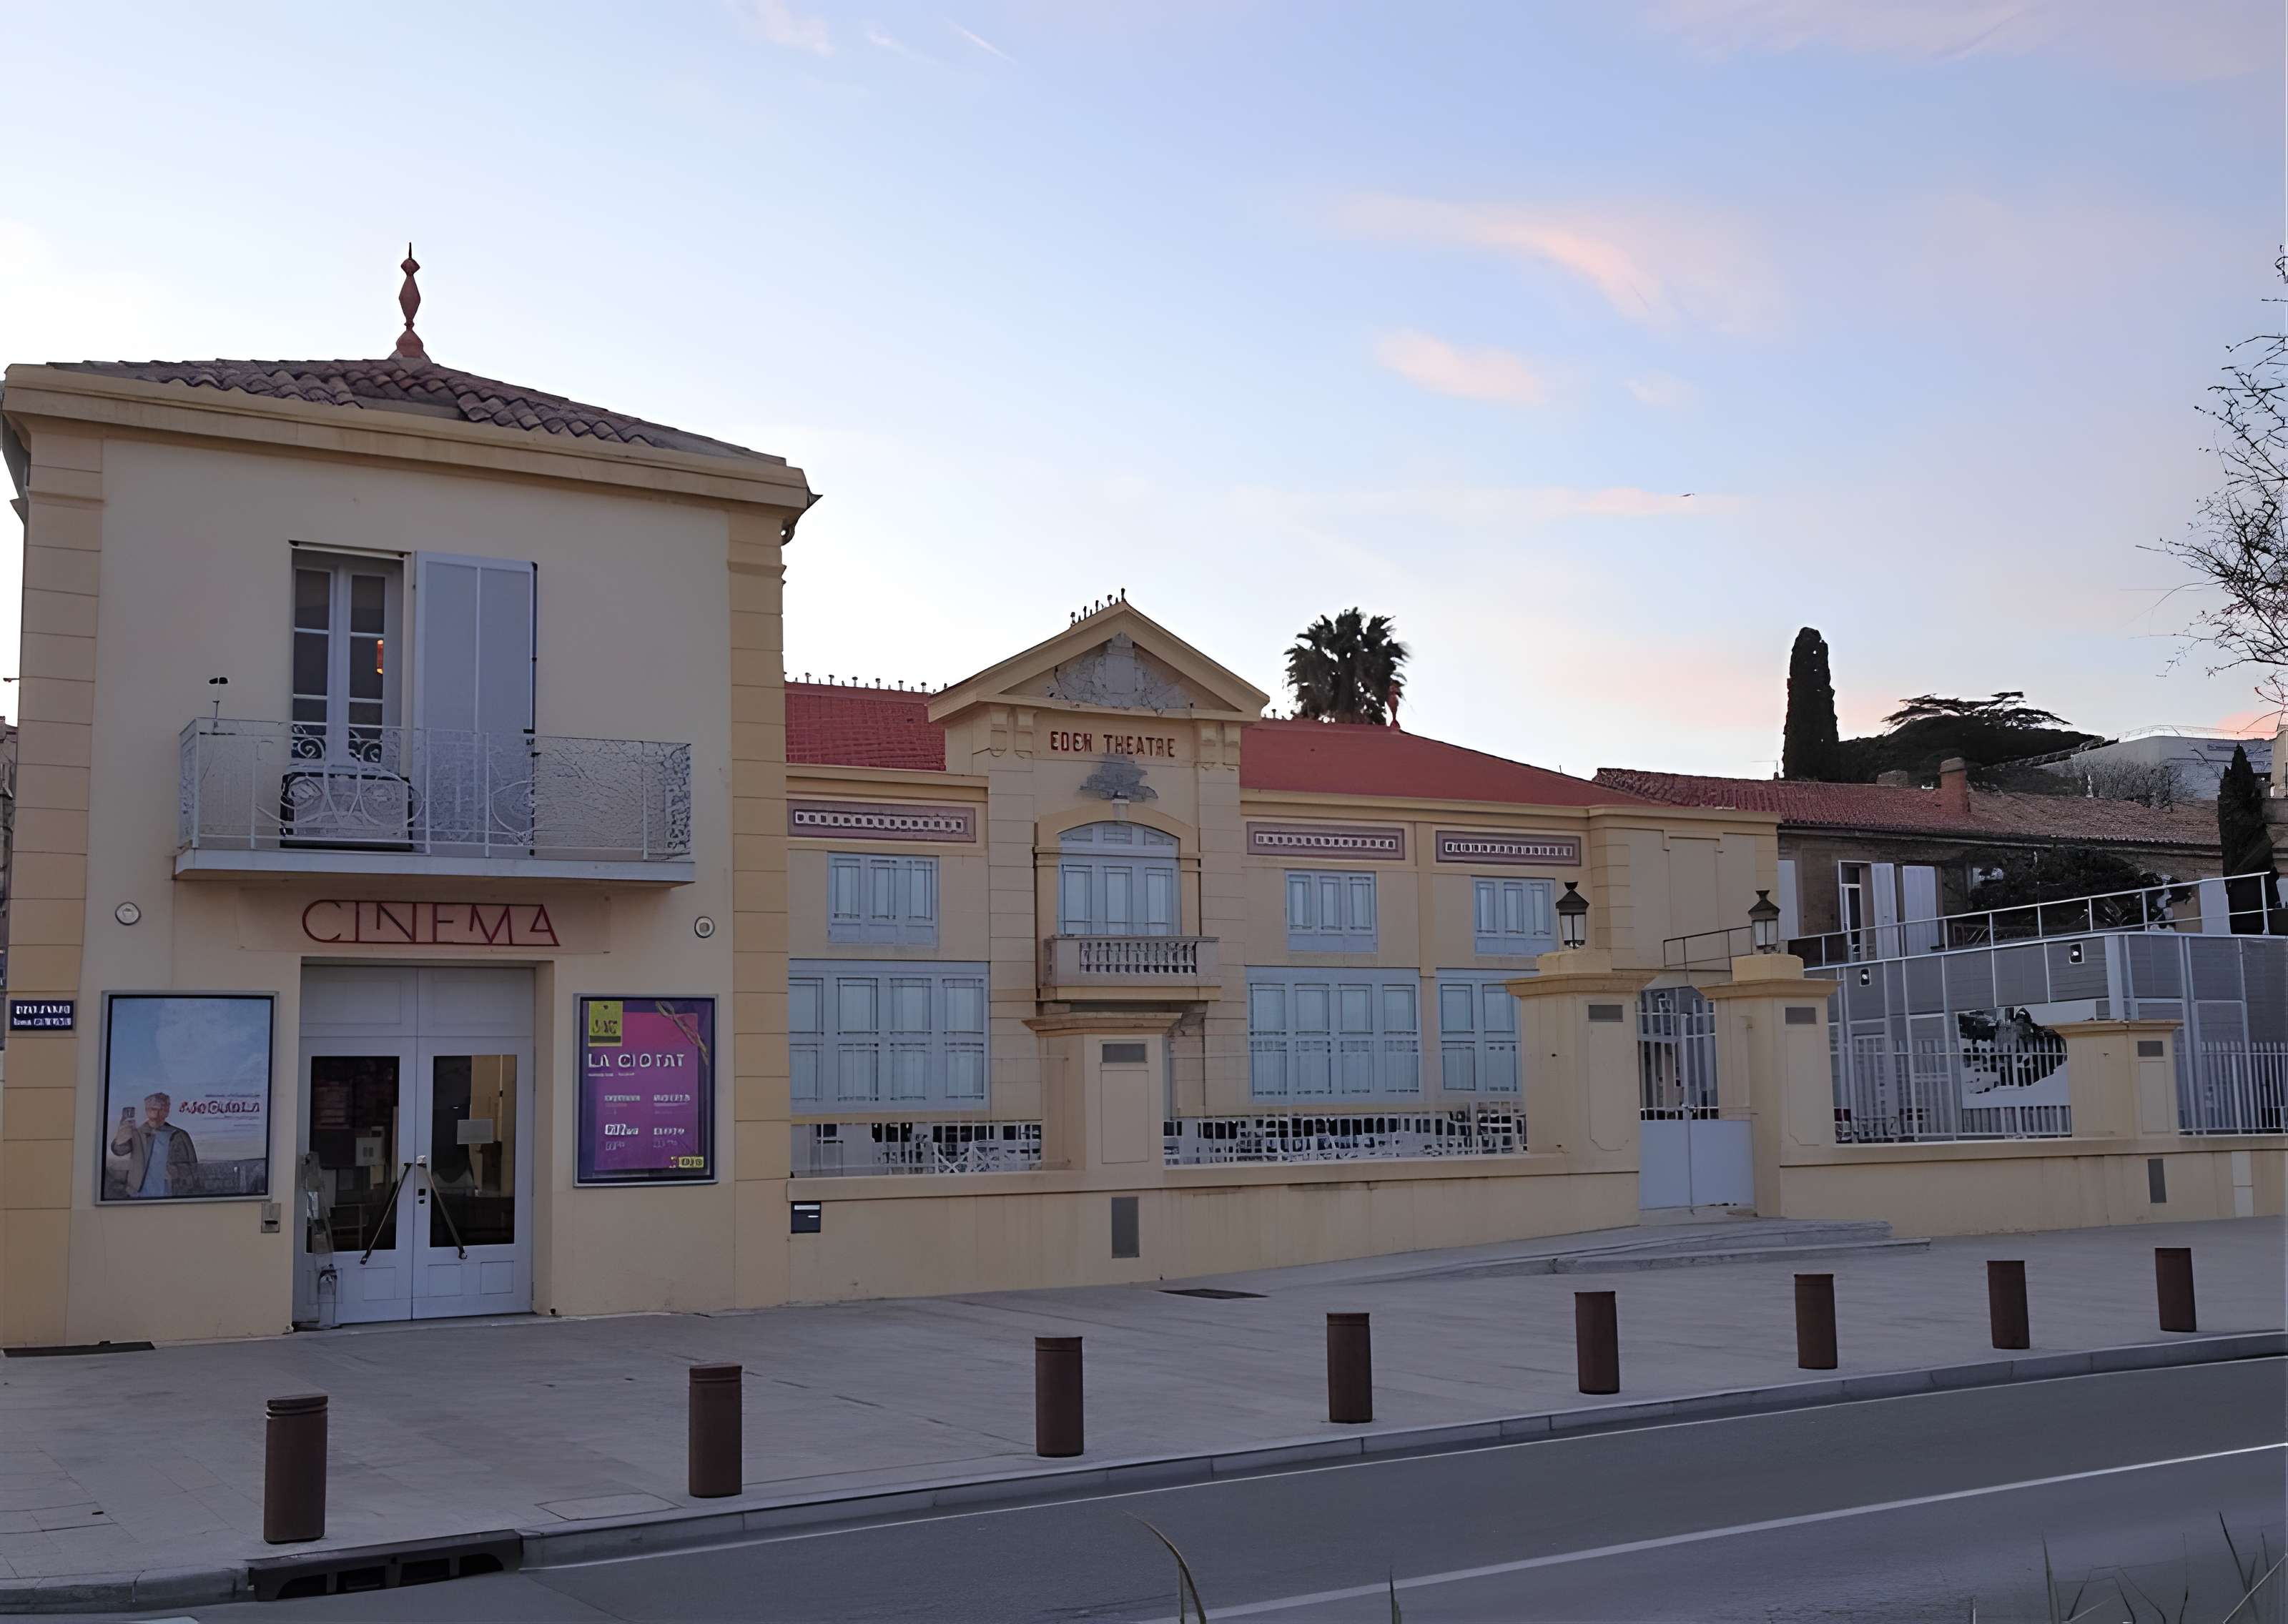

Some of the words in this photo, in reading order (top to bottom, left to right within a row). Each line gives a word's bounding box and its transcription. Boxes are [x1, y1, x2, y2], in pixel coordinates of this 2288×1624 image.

[1050, 731, 1093, 752] EDEN
[1103, 734, 1175, 758] THEATRE
[302, 899, 560, 946] CINEMA
[588, 1053, 610, 1068] LA
[618, 1053, 685, 1068] CIOTAT
